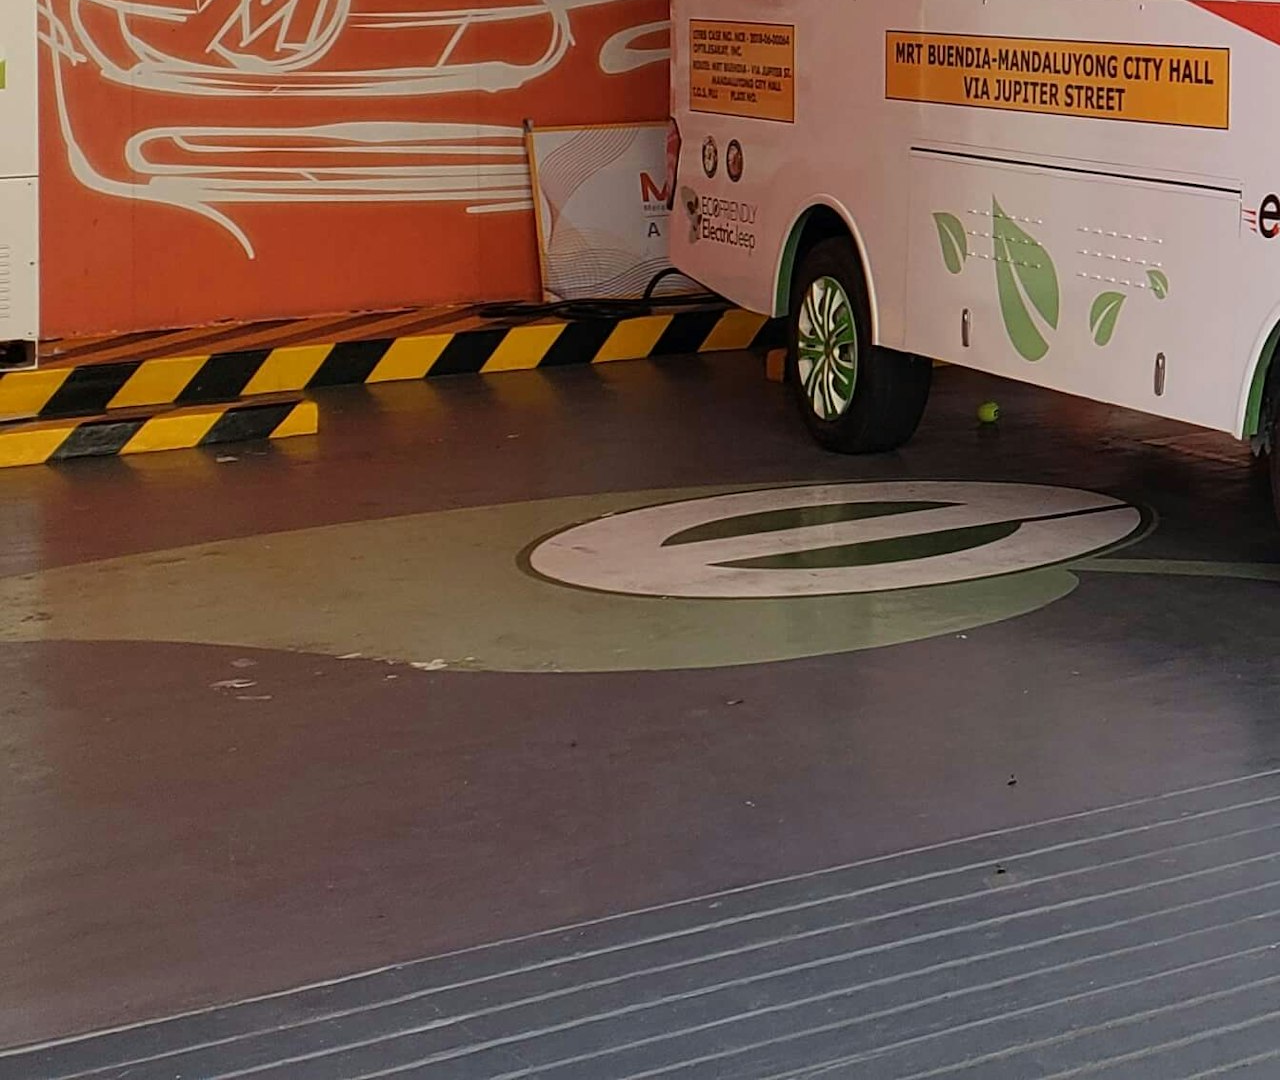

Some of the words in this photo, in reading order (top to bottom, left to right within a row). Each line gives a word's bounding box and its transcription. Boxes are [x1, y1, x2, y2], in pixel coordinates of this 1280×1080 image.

[895, 42, 924, 66] MRT
[927, 45, 1118, 80] BUENDIA-MANDALUYONG
[1123, 56, 1164, 82] CITY
[1168, 59, 1214, 86] HALL
[963, 76, 990, 101] VIA
[994, 79, 1059, 107] JUPITER
[1064, 85, 1126, 112] STREET
